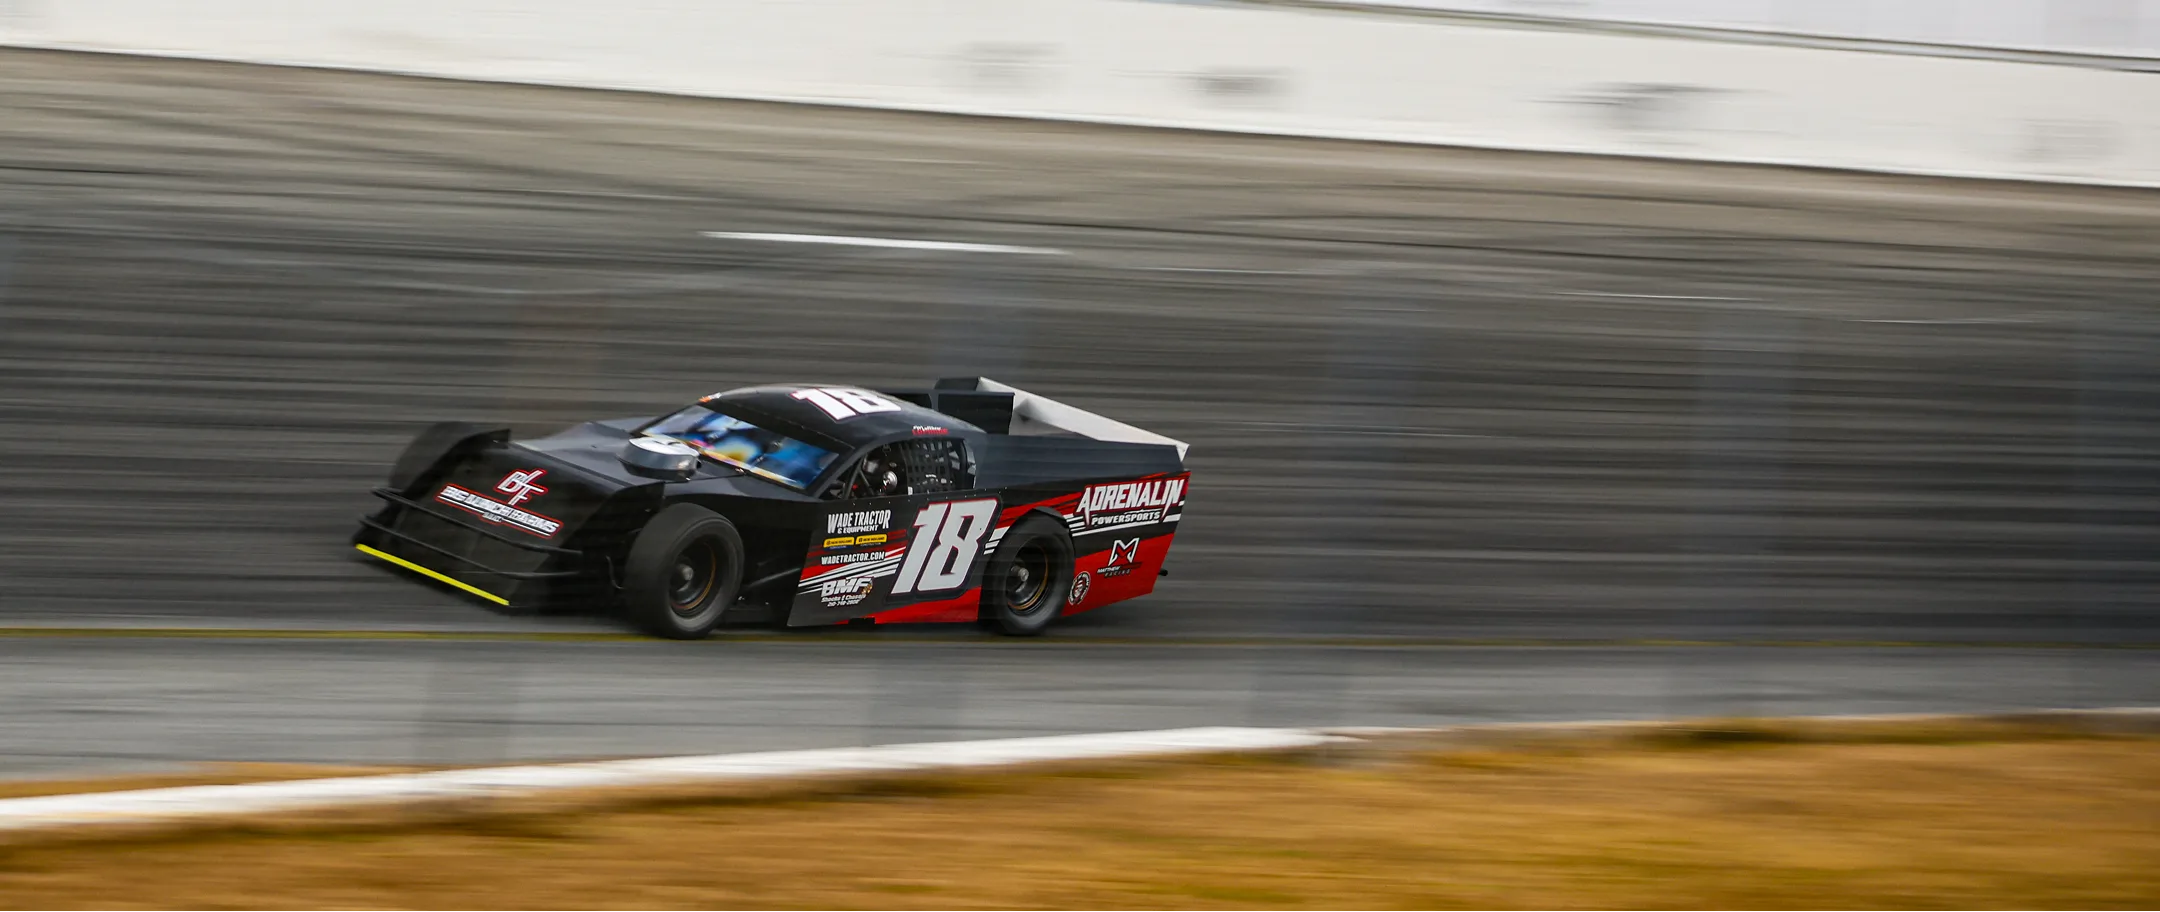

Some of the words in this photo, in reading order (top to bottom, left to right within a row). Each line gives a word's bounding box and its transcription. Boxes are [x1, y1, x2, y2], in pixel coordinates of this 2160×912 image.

[790, 387, 901, 421] 18
[1076, 479, 1185, 526] ADRENALIN
[828, 513, 853, 534] WADE
[854, 510, 891, 529] TRACTOR
[1091, 512, 1161, 525] POWERSPORTS
[843, 525, 879, 534] EQUIPMENT
[890, 499, 998, 594] 18
[822, 551, 884, 565] WADETRACTOR.COM
[821, 578, 872, 597] BMF
